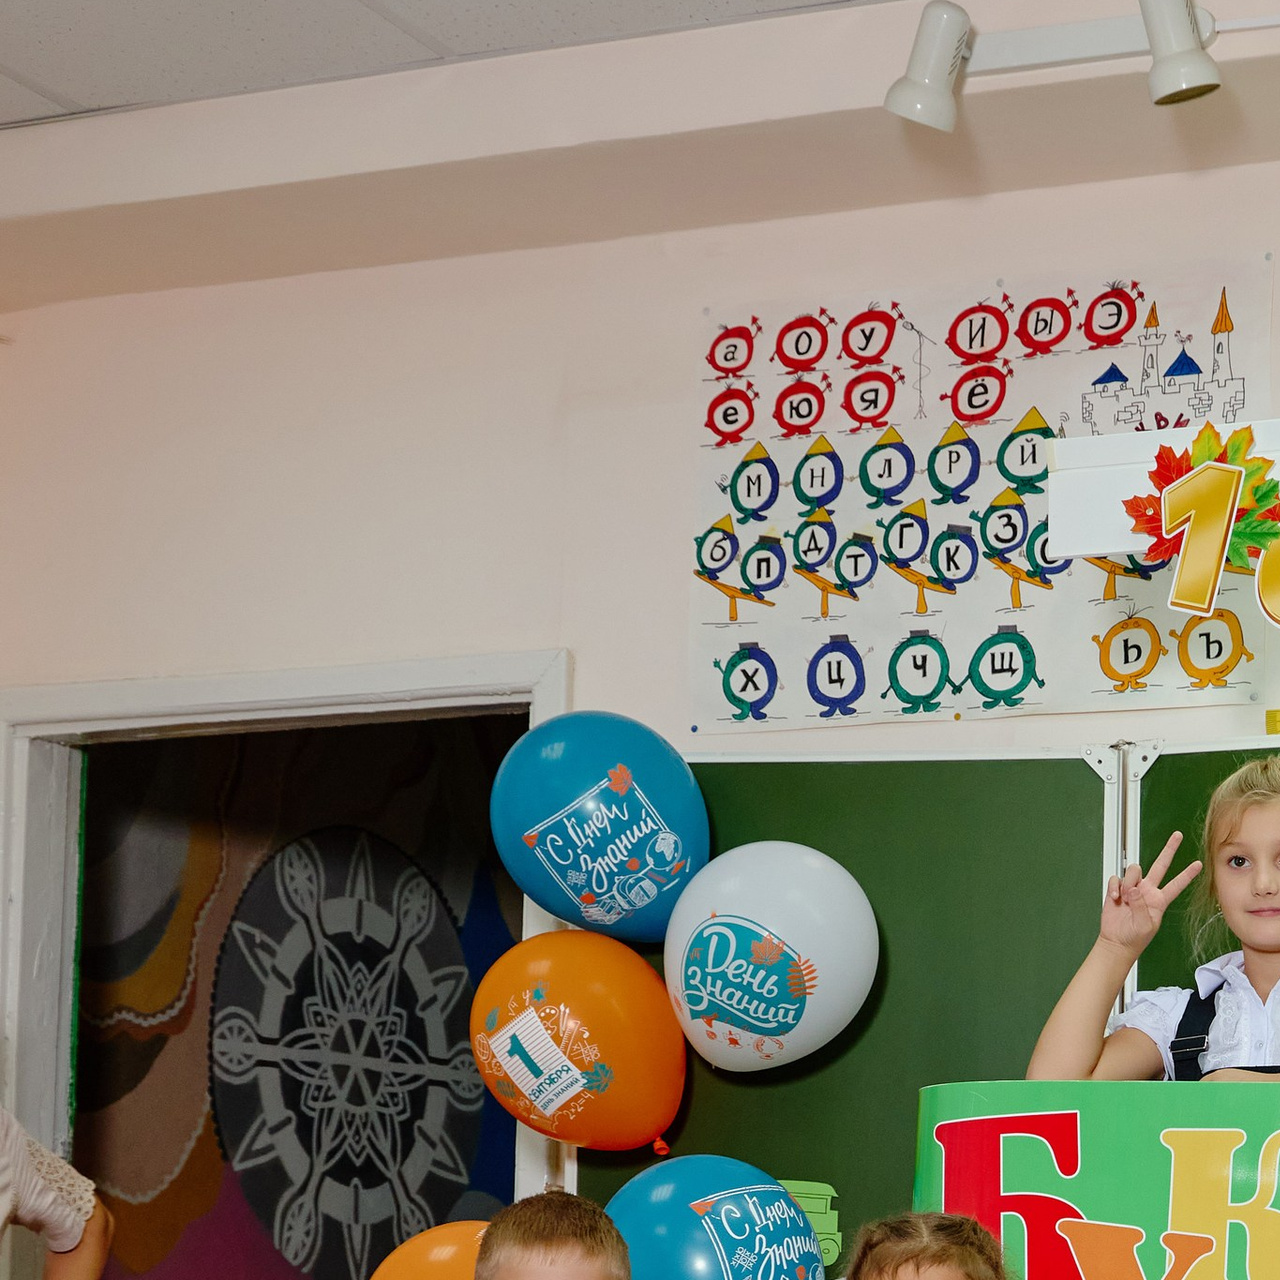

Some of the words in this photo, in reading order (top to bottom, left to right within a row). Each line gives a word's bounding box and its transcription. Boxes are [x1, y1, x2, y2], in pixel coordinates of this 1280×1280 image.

[1160, 462, 1244, 616] 1
[702, 925, 779, 998] День
[682, 966, 800, 1028] Знаний
[506, 1033, 544, 1080] 1
[529, 1064, 573, 1102] СЕНТЯБРЯ
